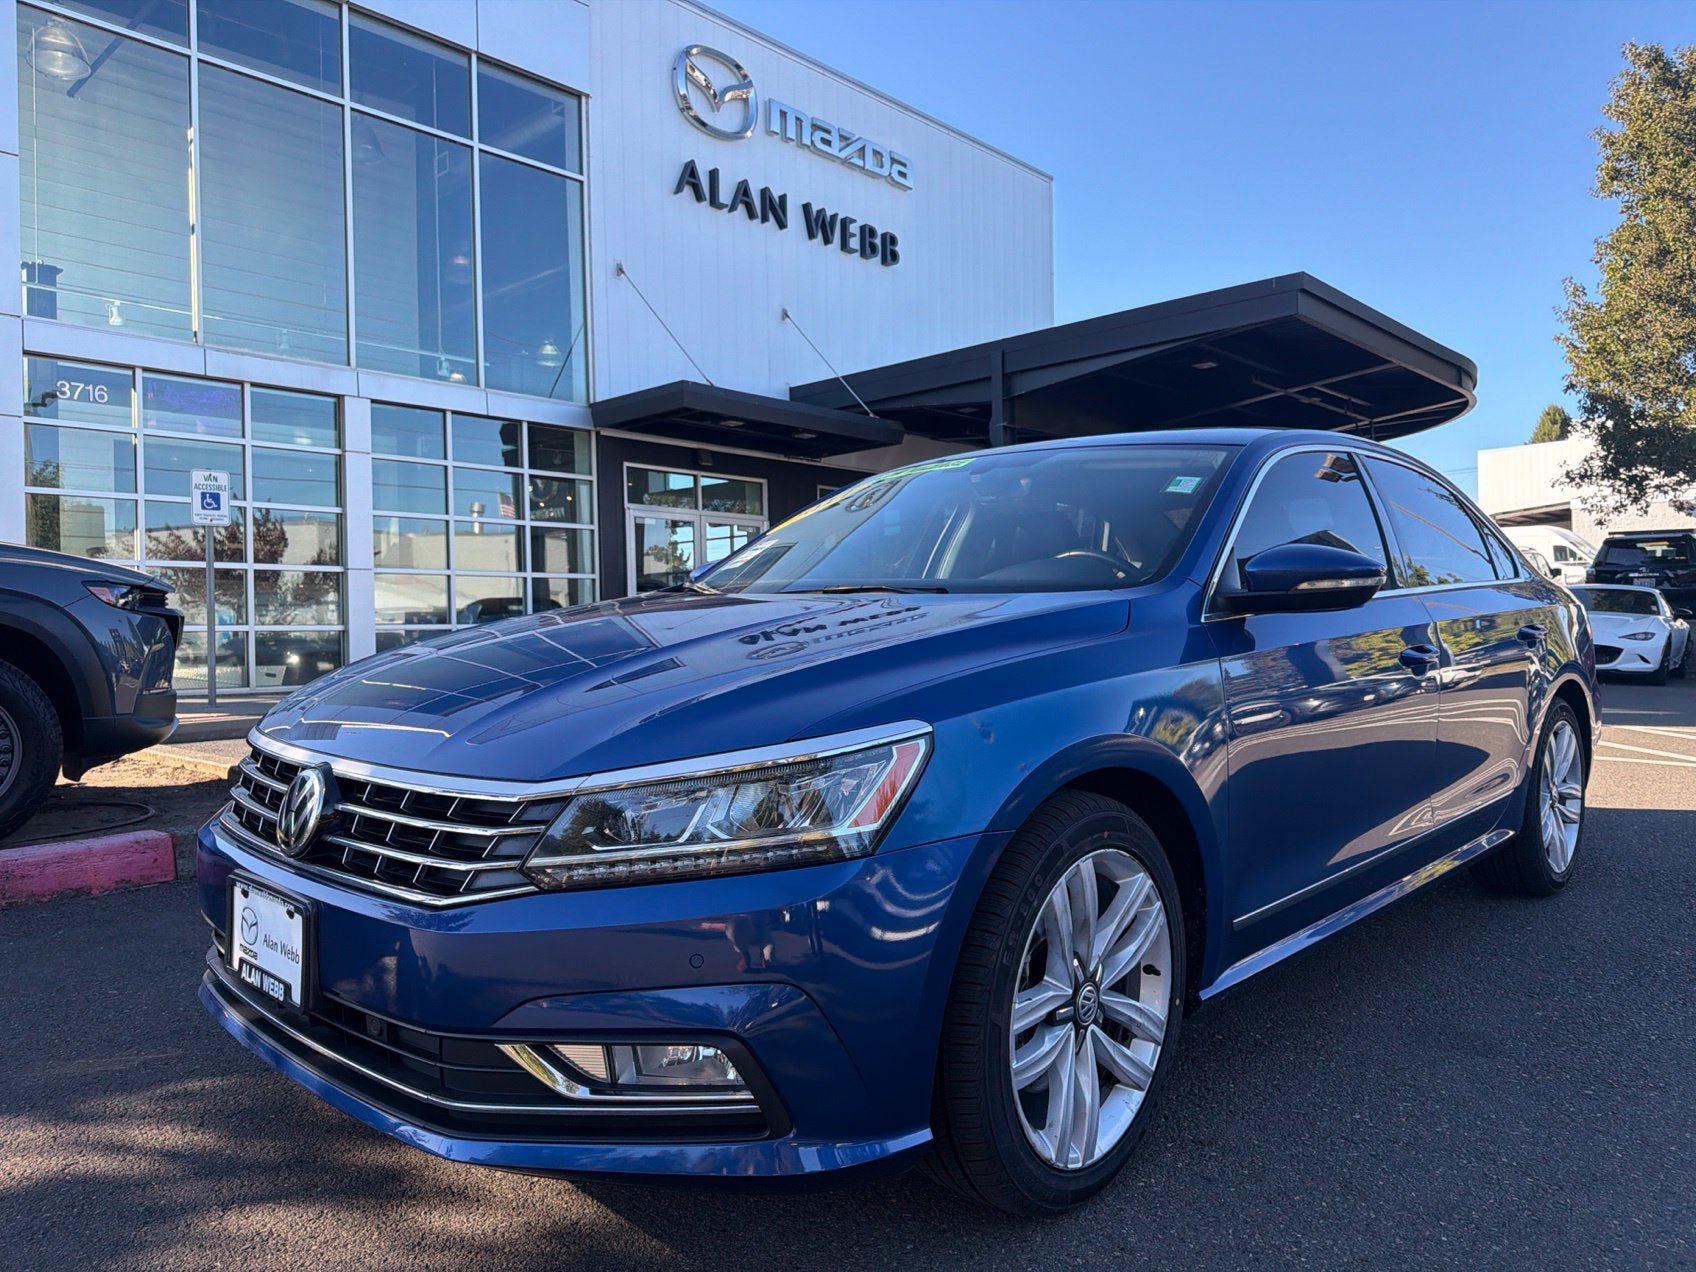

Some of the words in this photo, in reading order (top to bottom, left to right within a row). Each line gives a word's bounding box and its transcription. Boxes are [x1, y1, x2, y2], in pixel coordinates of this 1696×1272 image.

[764, 97, 914, 191] mazda
[673, 158, 788, 231] ALAN
[801, 201, 900, 267] WEBB
[56, 380, 108, 403] 3716
[193, 483, 227, 492] ACCESSIBLE
[202, 474, 218, 483] VAN
[263, 933, 279, 953] Alan
[279, 940, 300, 965] Webb
[240, 962, 261, 988] ALAN
[262, 973, 285, 1001] WEBB
